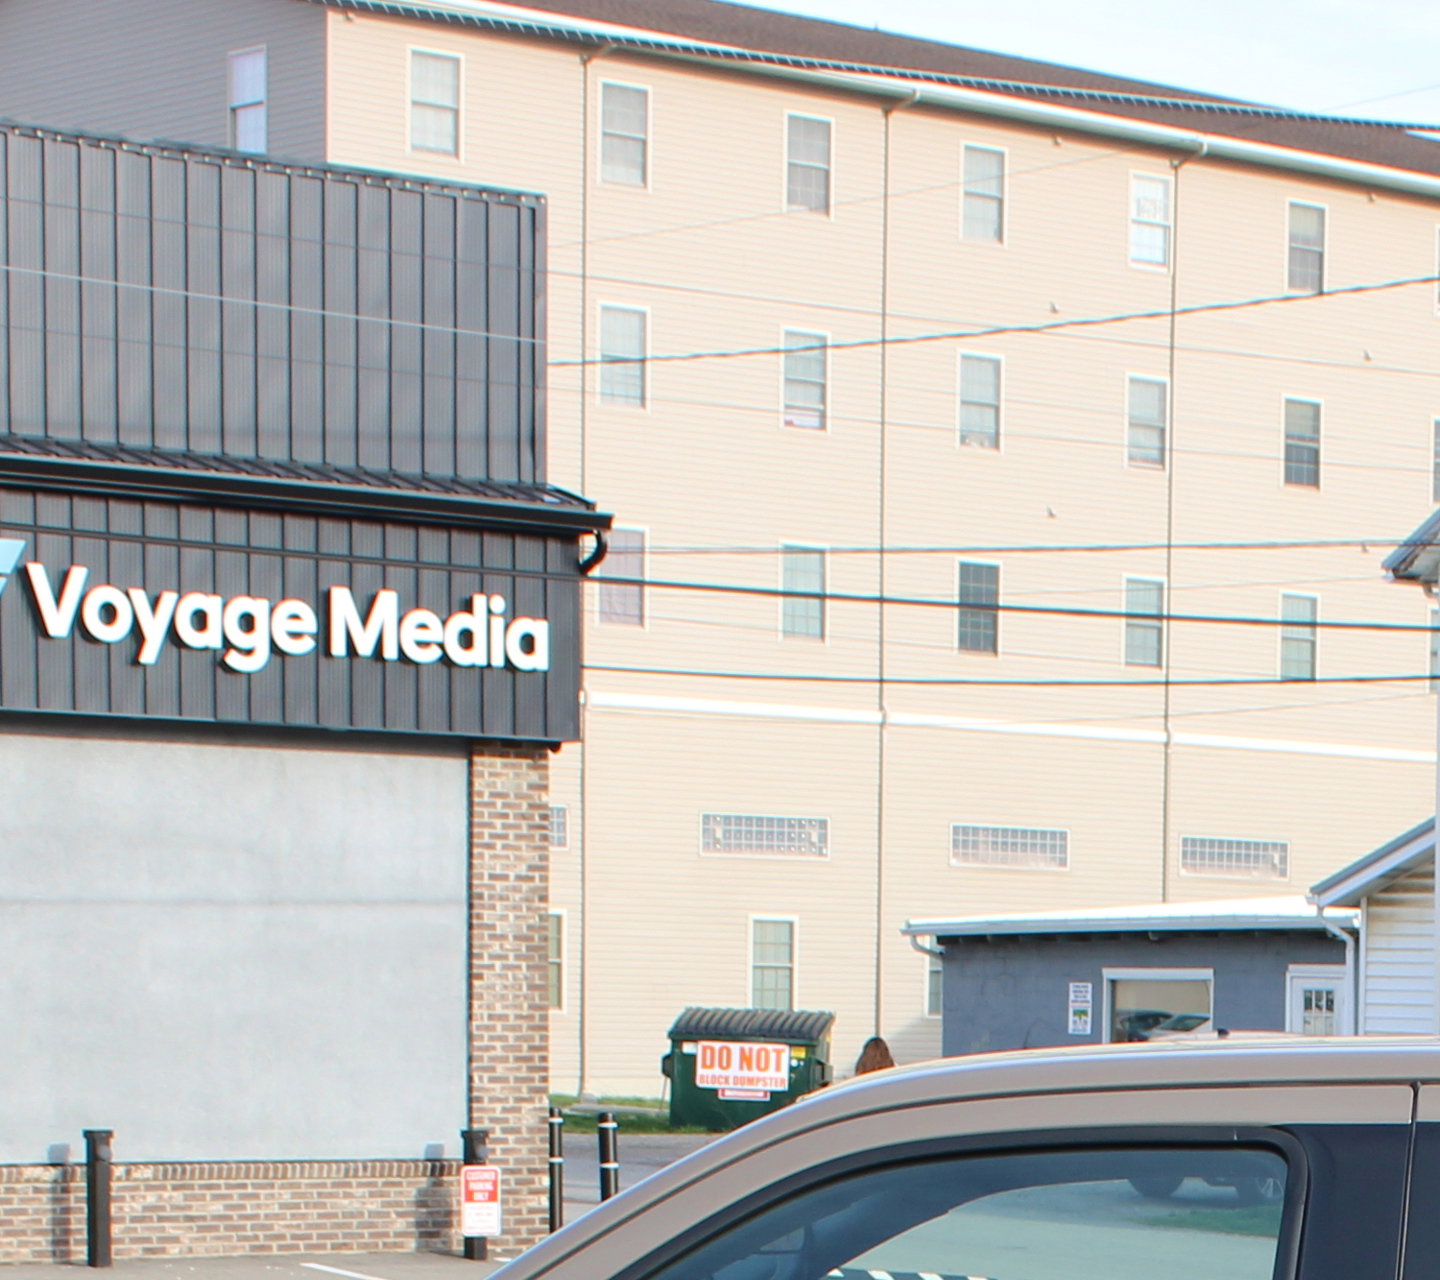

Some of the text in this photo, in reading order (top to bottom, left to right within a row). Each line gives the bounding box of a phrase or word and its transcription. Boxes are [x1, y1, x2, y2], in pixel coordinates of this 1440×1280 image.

[26, 562, 551, 674] Voyage Media
[700, 1045, 786, 1073] DO NOT
[699, 1074, 787, 1088] BLOCK DUMPSTER
